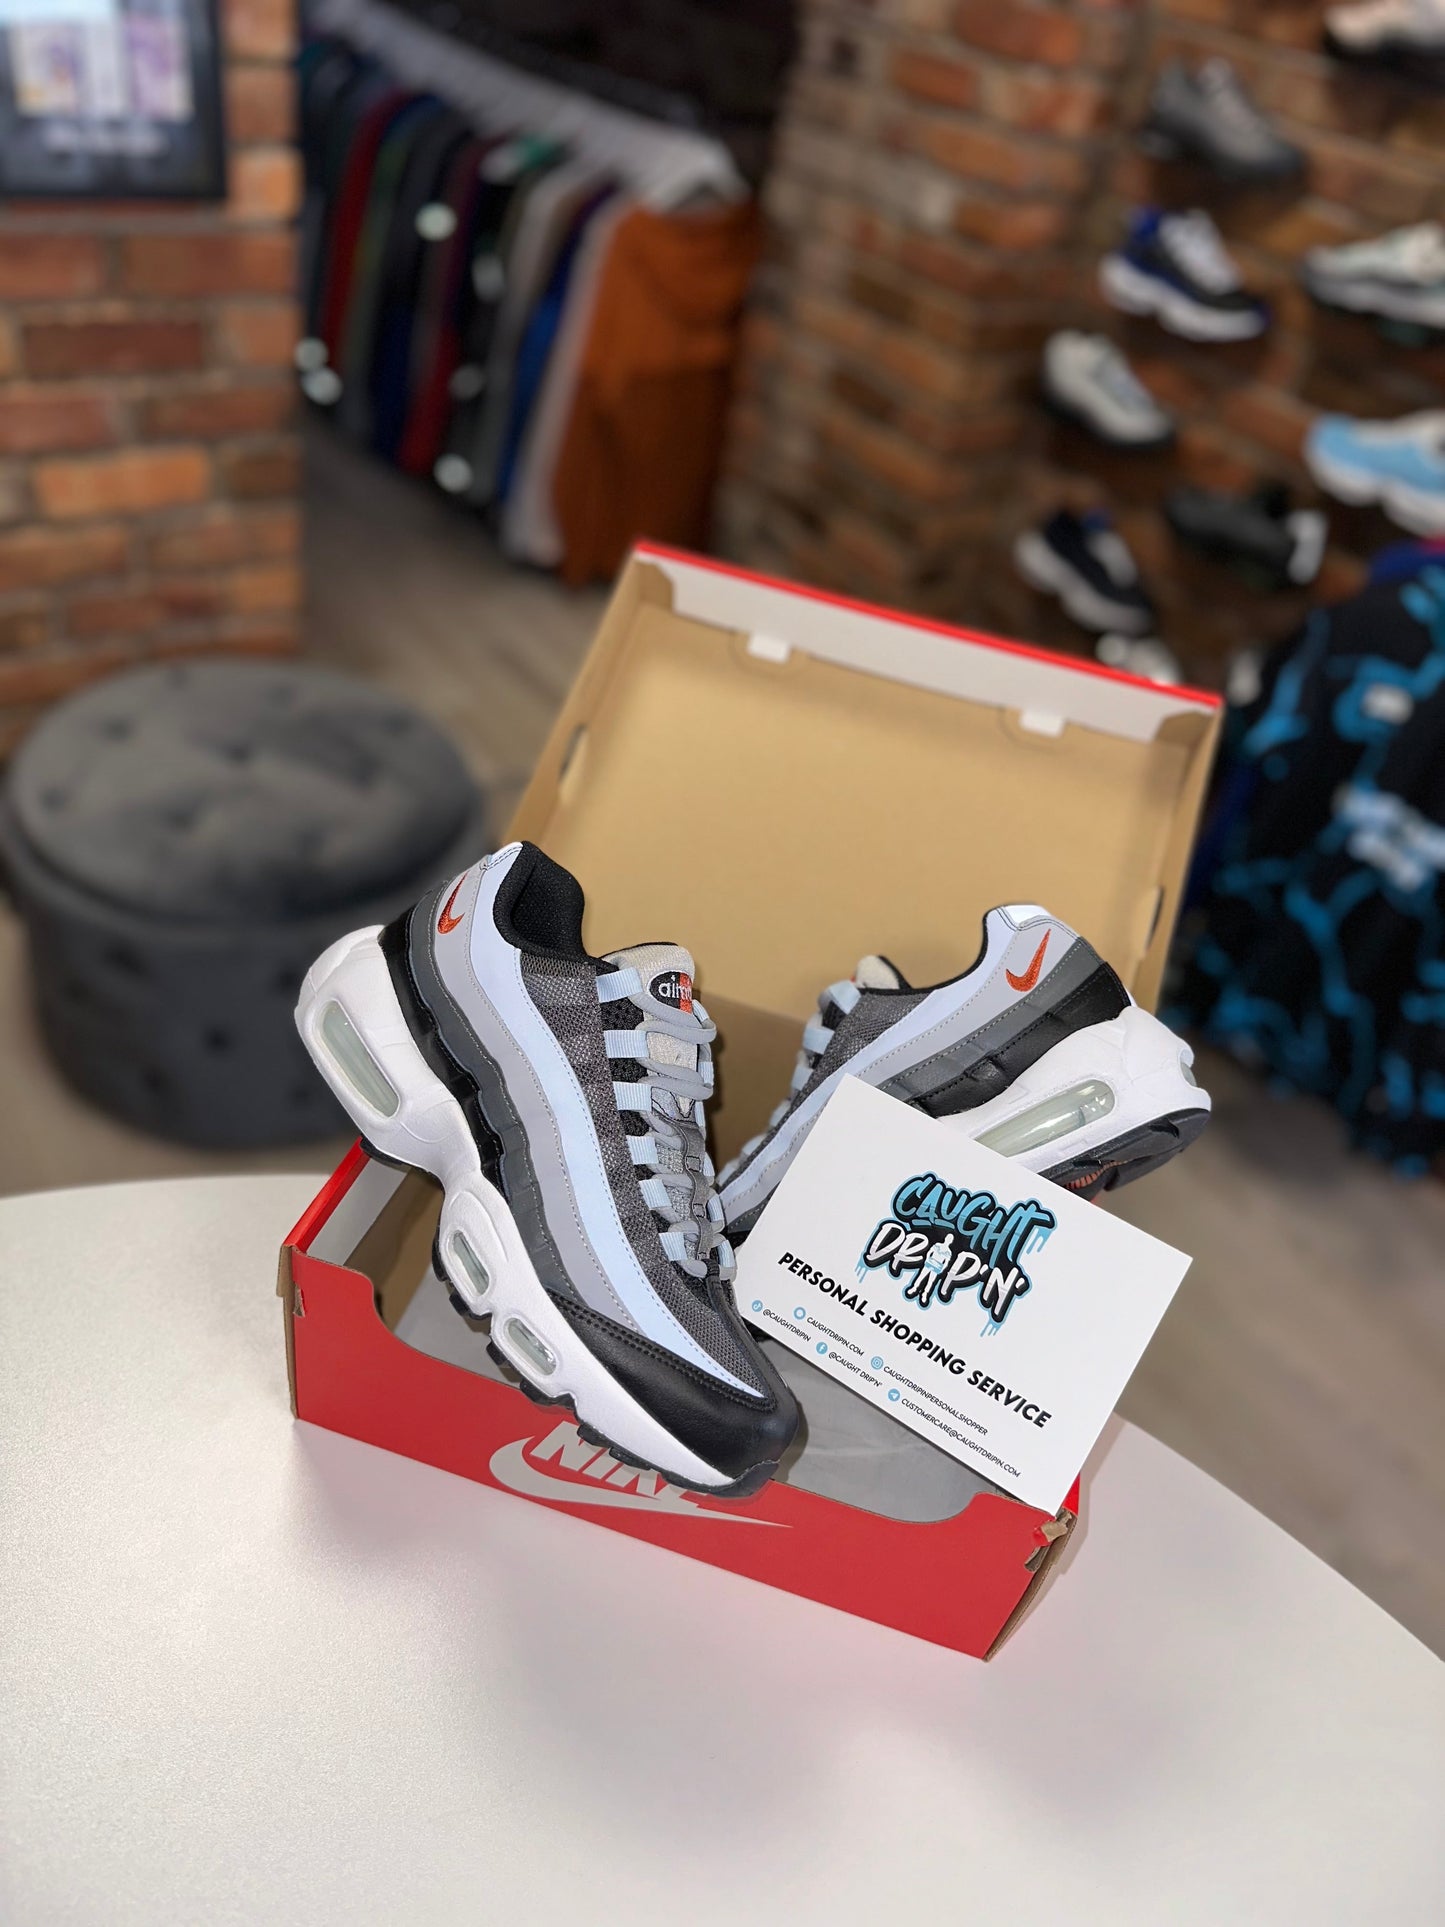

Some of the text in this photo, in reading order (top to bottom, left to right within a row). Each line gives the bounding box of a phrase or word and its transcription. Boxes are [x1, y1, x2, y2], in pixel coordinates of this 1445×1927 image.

[892, 1173, 1055, 1263] CAUGHT
[778, 1251, 1052, 1428] PERSONAL SHOPPING SERVICE
